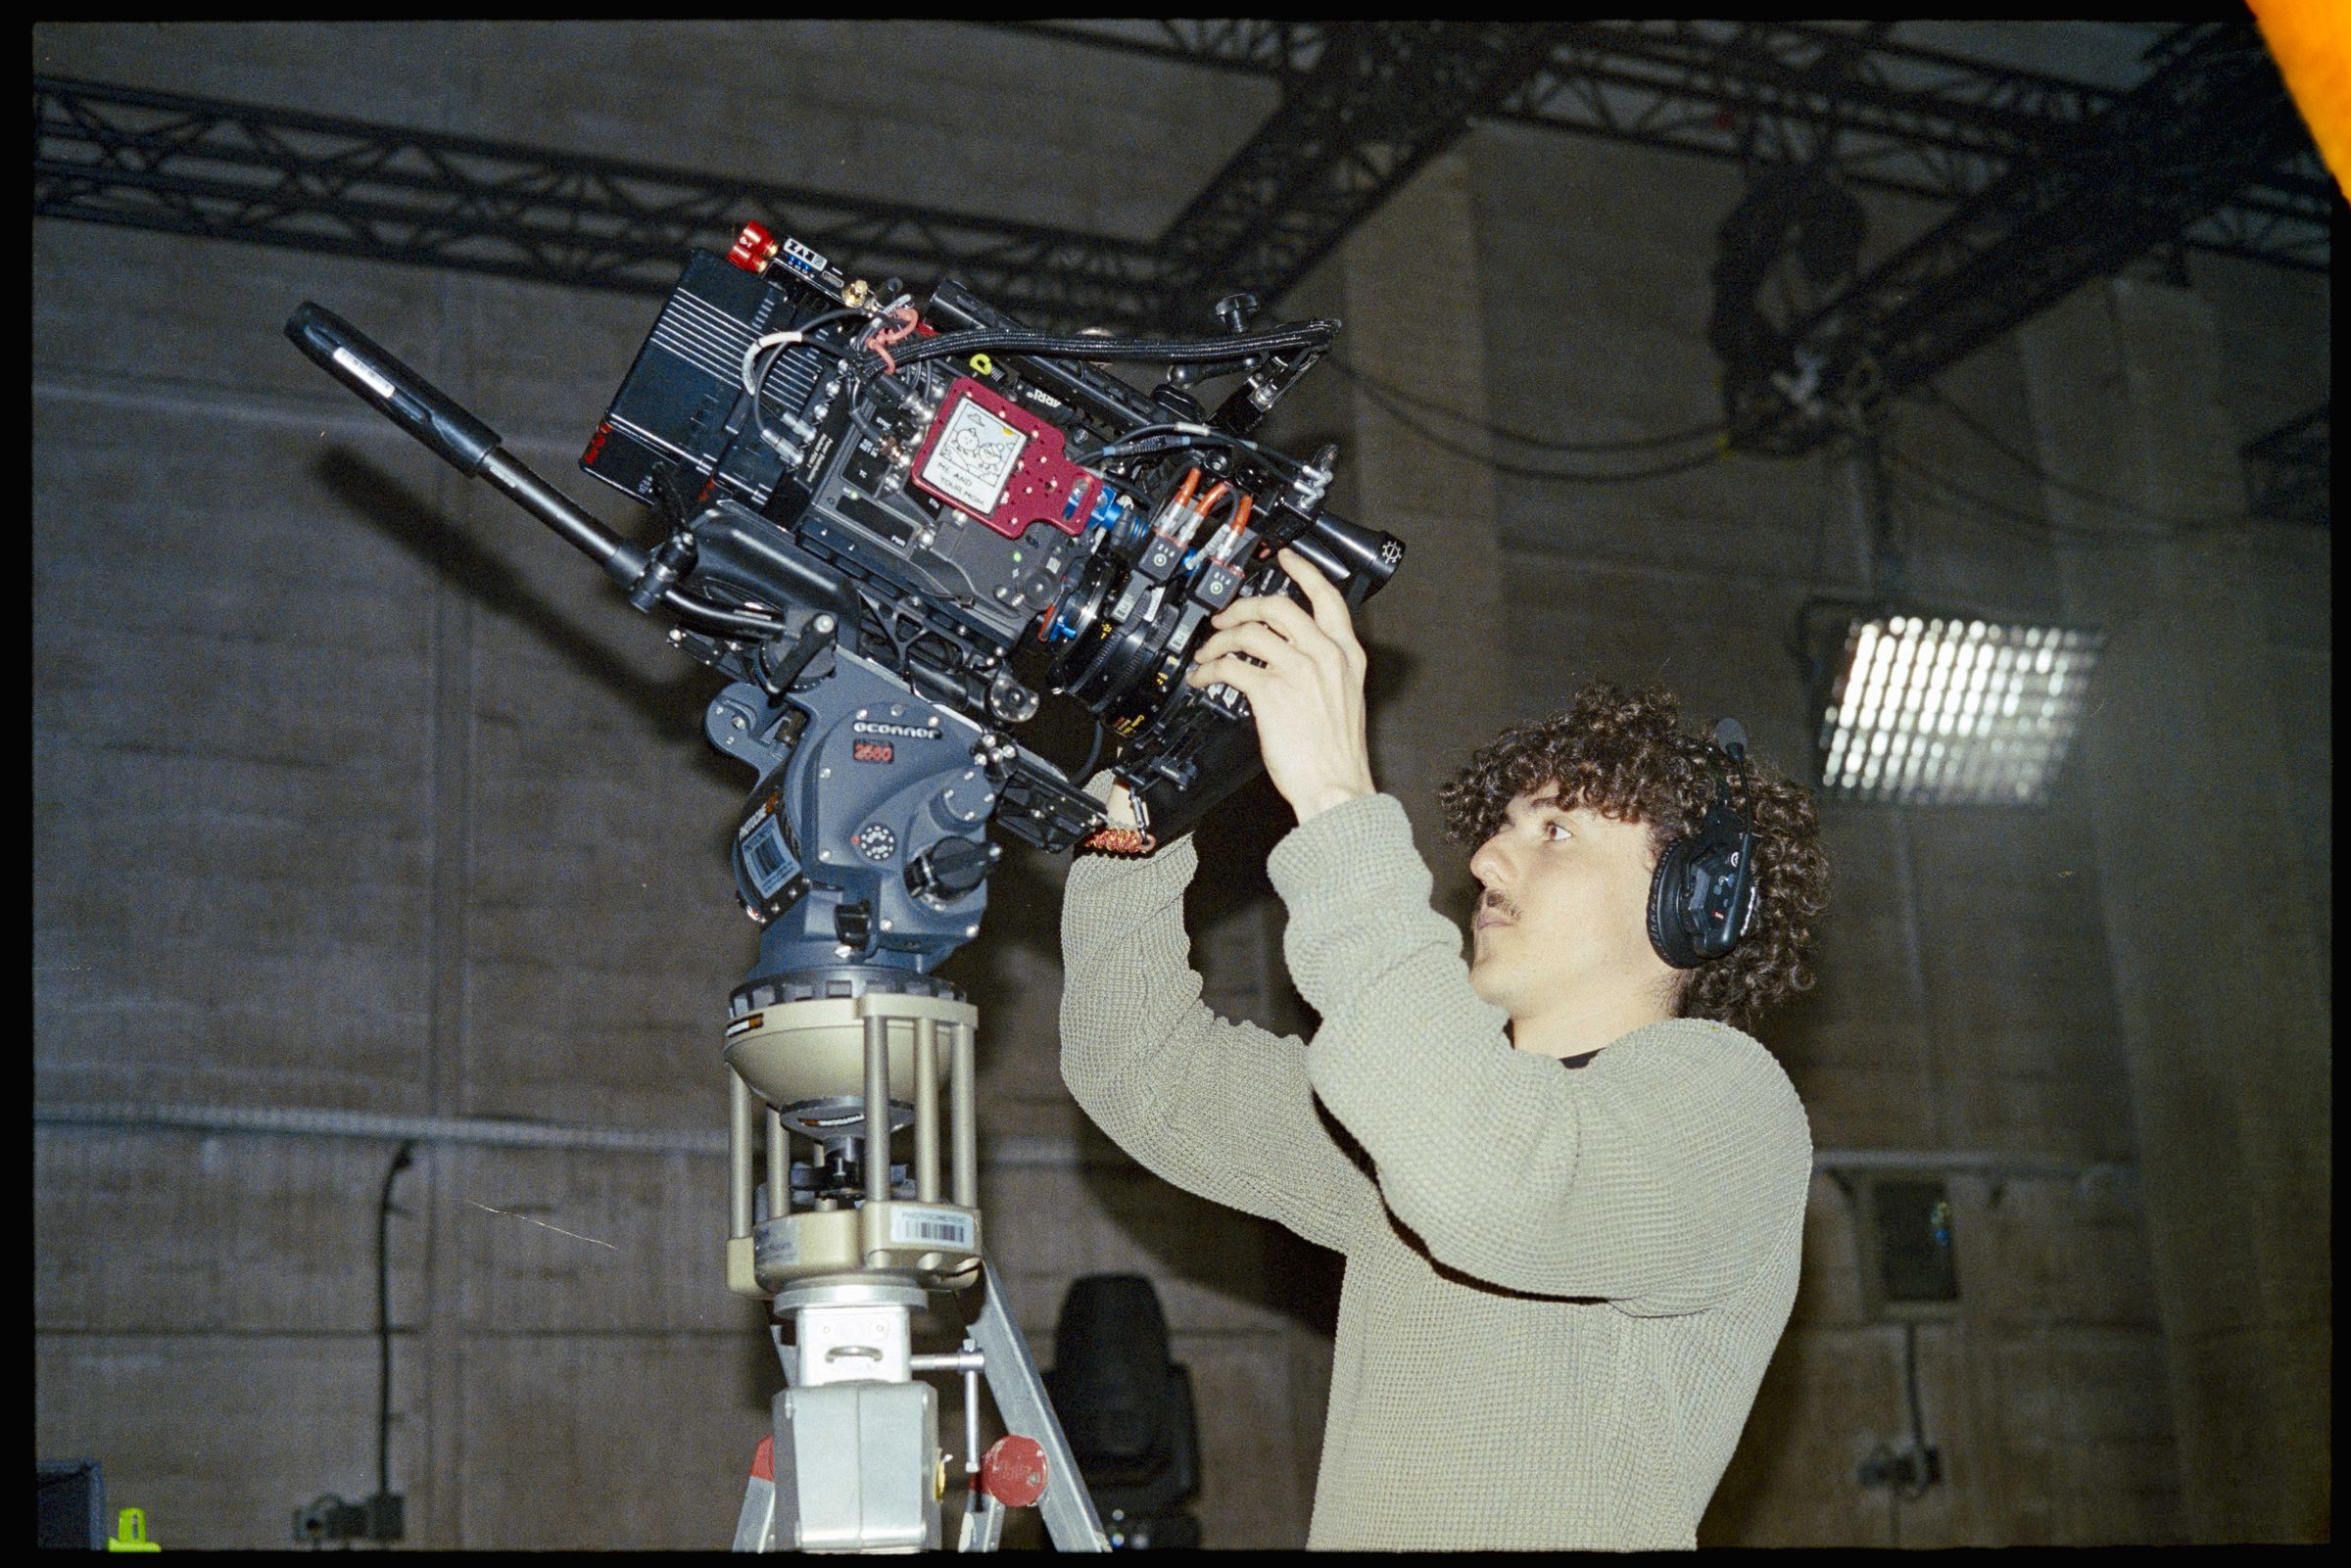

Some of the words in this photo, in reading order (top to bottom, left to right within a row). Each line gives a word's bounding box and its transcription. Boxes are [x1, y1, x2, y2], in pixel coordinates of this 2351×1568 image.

[1033, 389, 1062, 408] ARRI
[938, 461, 950, 474] ME
[953, 473, 973, 486] AND
[940, 477, 962, 494] YOUR
[964, 491, 984, 504] MOM
